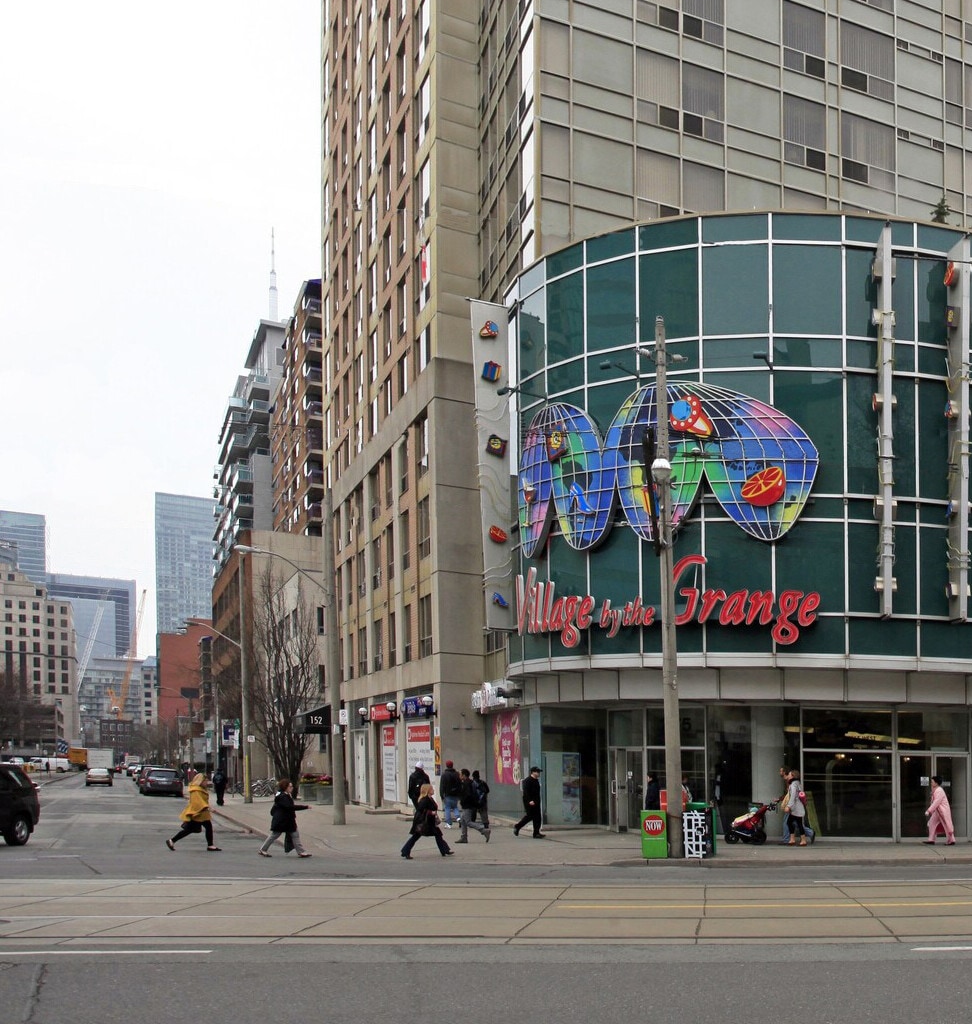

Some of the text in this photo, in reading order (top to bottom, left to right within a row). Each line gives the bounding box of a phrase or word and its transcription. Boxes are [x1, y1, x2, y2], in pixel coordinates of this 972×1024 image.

[516, 555, 821, 648] Village by the Grange
[310, 716, 323, 725] 152
[645, 819, 663, 831] NOW
